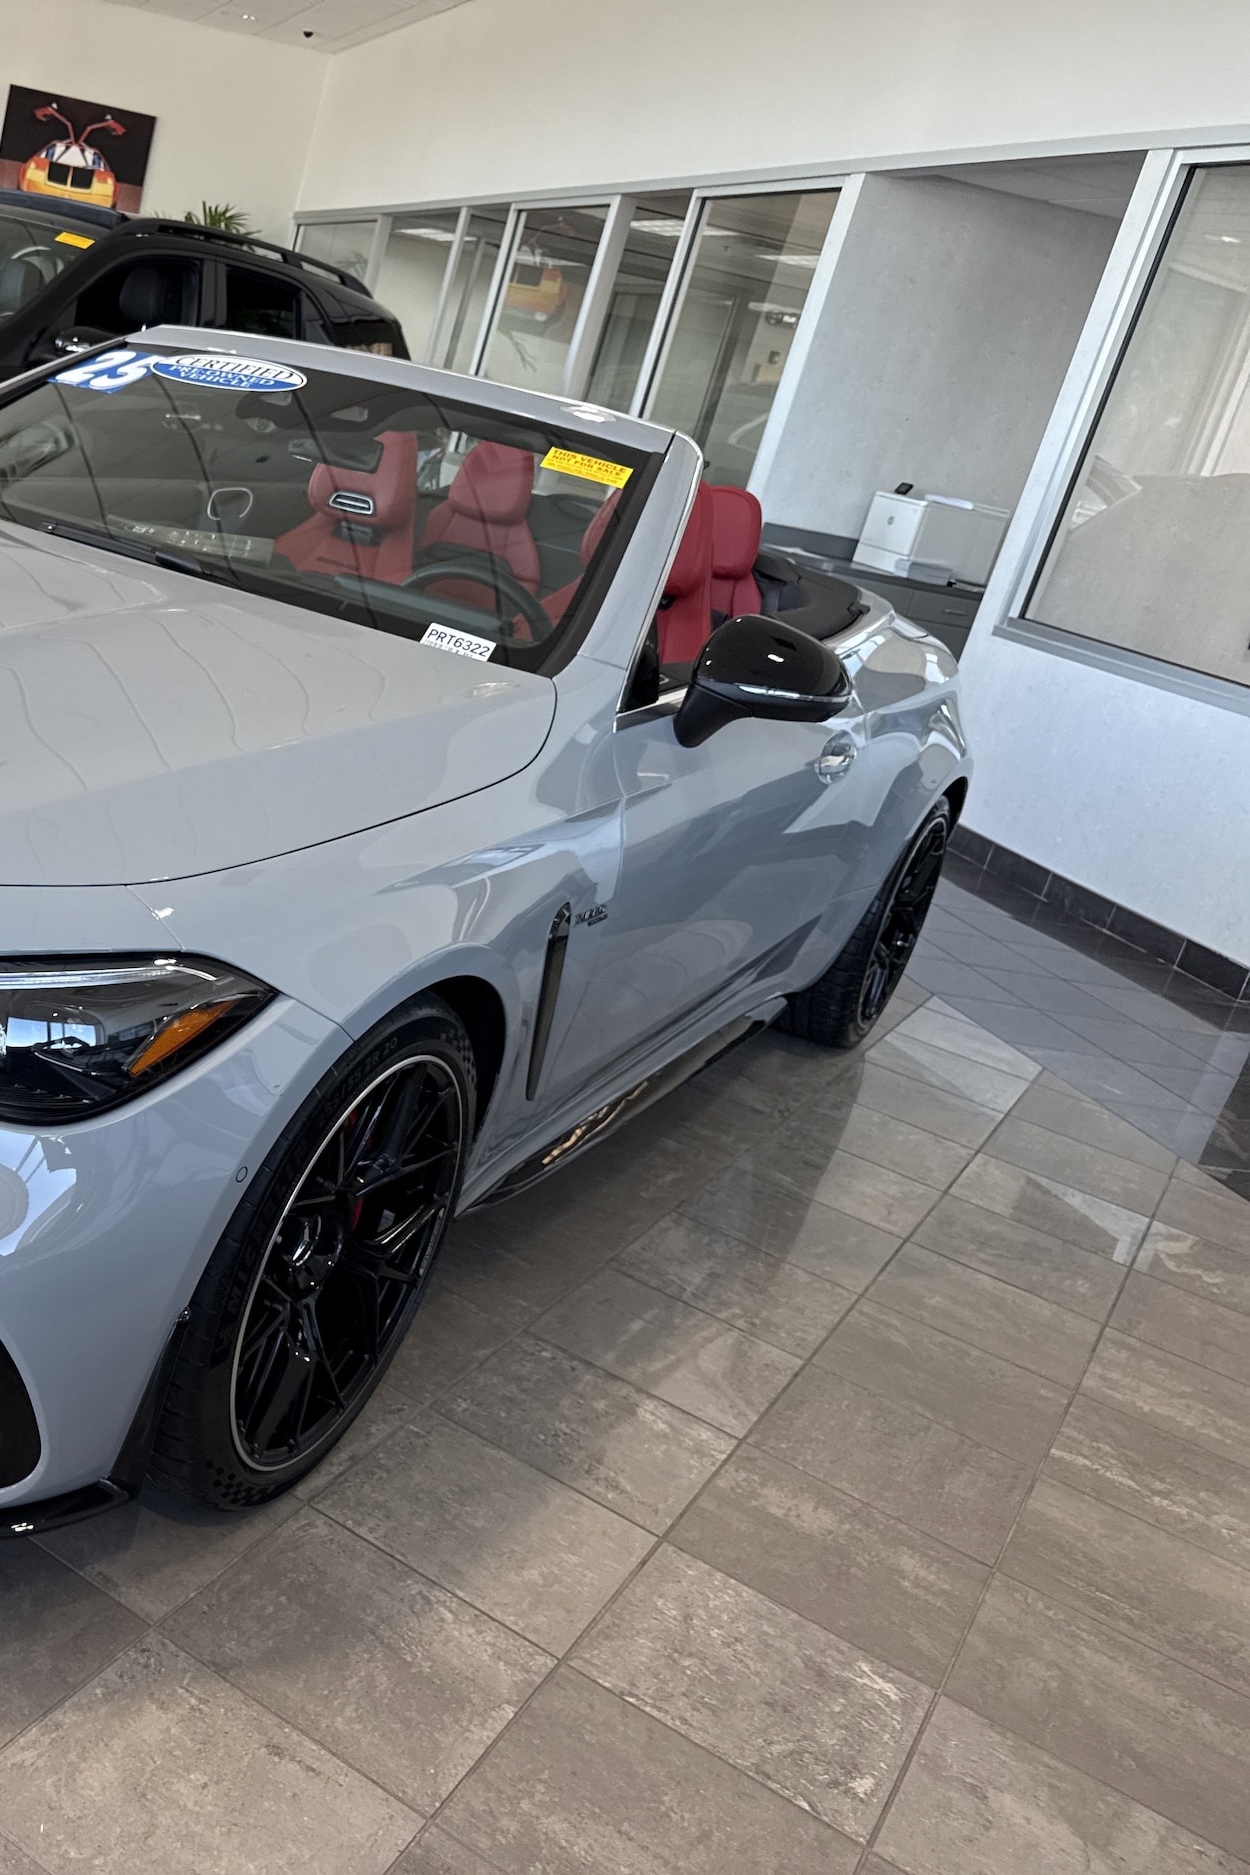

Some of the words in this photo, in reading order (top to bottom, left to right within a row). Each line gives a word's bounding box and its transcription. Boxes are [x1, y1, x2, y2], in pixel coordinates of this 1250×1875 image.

[55, 351, 167, 390] 25
[176, 356, 294, 380] CERTIFIED
[180, 371, 251, 388] VEHICLE
[552, 454, 571, 463] NOT
[573, 460, 594, 469] FOR
[596, 466, 622, 477] SALE
[553, 449, 577, 460] THIS
[580, 456, 626, 474] VEHICLE
[427, 628, 491, 658] PRT6322
